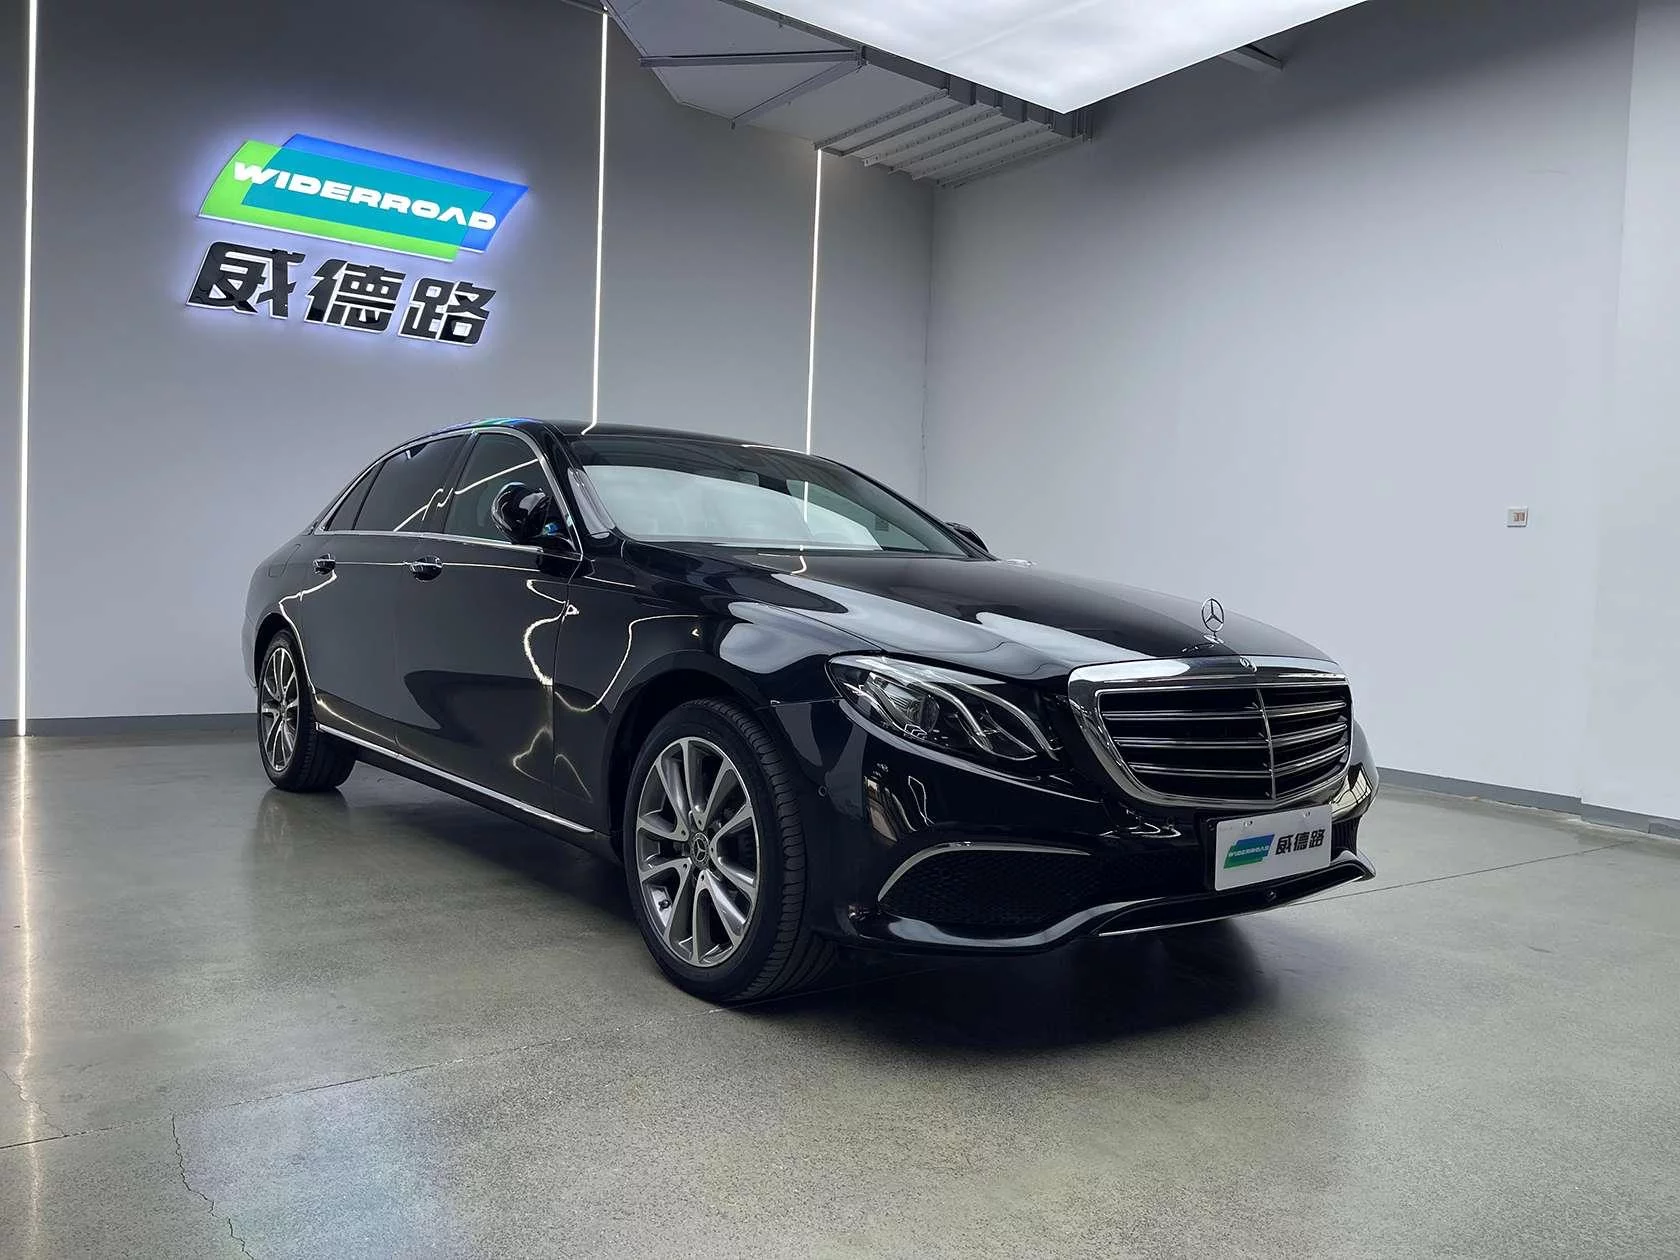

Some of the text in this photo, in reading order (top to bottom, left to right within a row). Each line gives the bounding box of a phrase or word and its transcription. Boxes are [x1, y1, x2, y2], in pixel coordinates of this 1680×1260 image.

[233, 161, 497, 231] WIDERROAD
[185, 241, 497, 346] 威德路
[1275, 829, 1325, 855] 威德路
